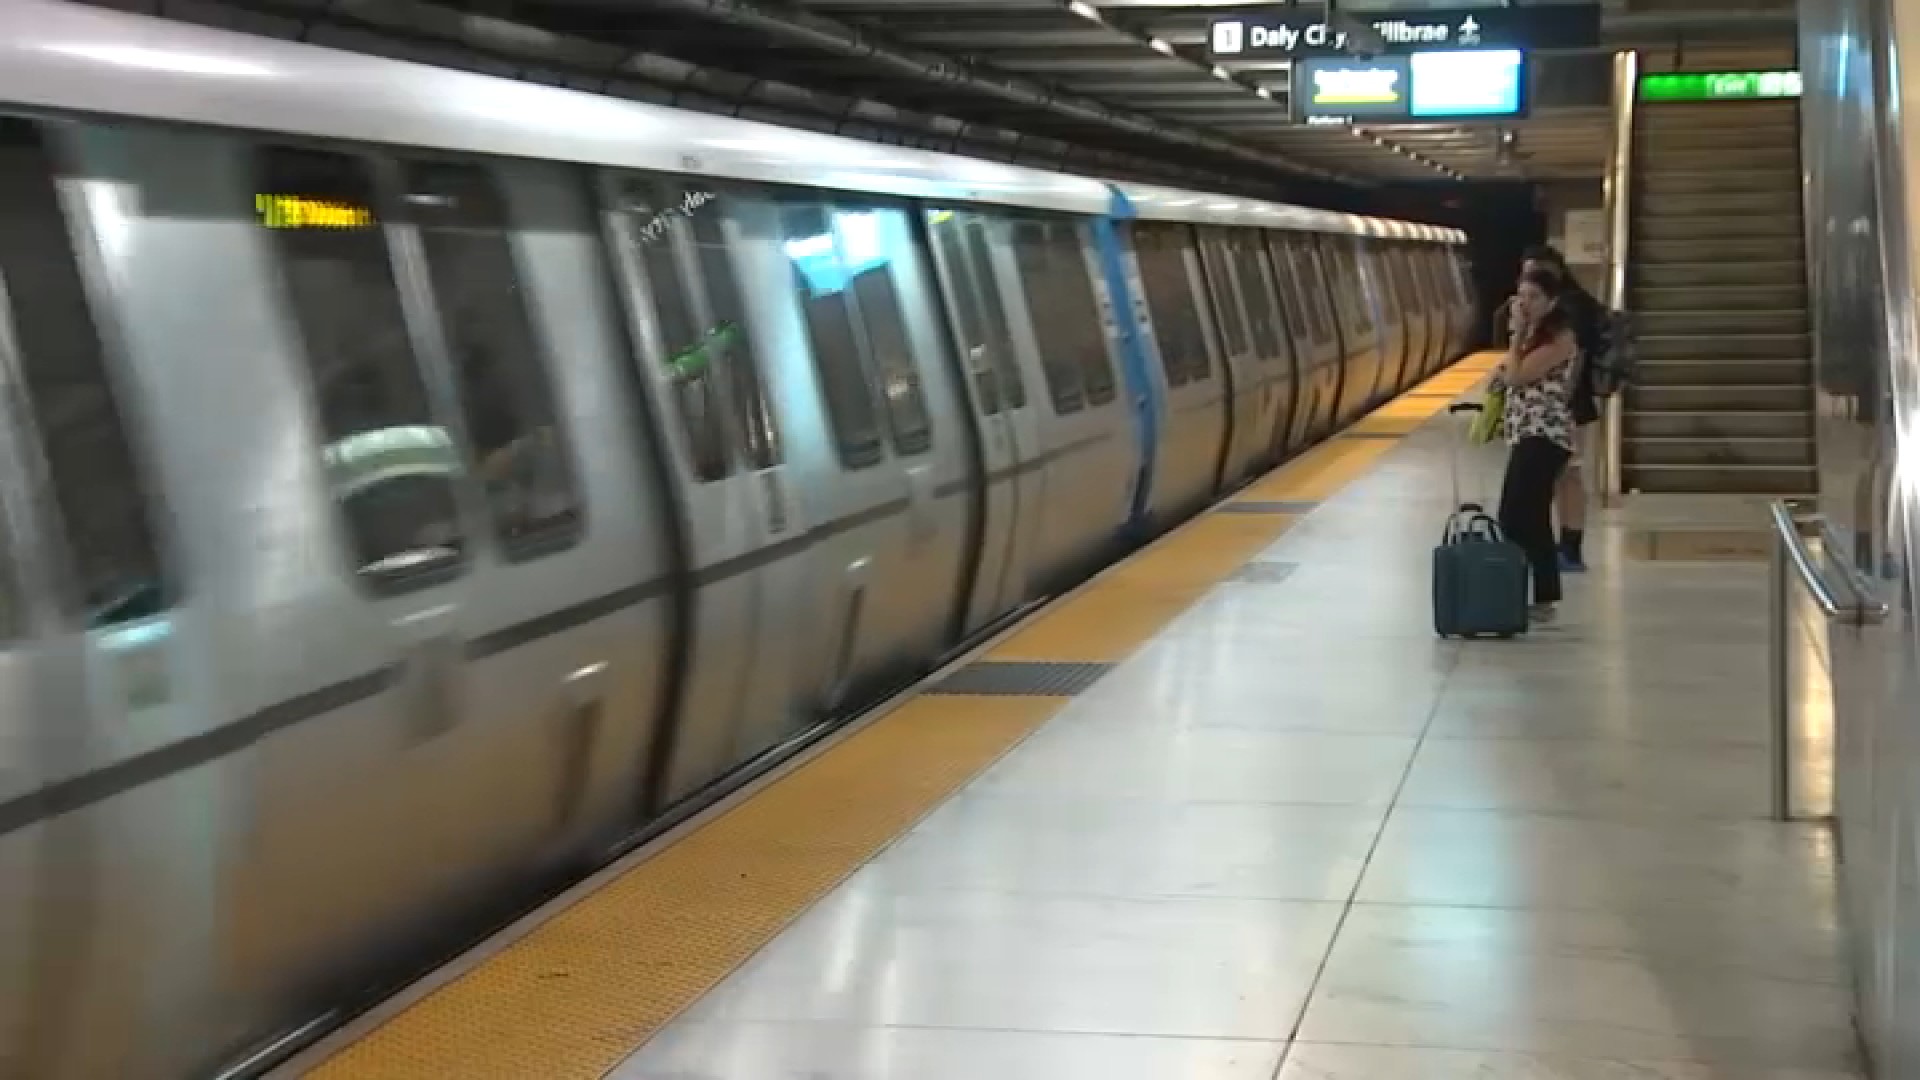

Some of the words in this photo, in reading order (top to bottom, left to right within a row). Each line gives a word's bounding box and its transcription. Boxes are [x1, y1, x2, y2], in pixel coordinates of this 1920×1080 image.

[1250, 24, 1299, 50] Daly
[1304, 23, 1348, 50] Ciy
[1372, 20, 1449, 43] illbrae
